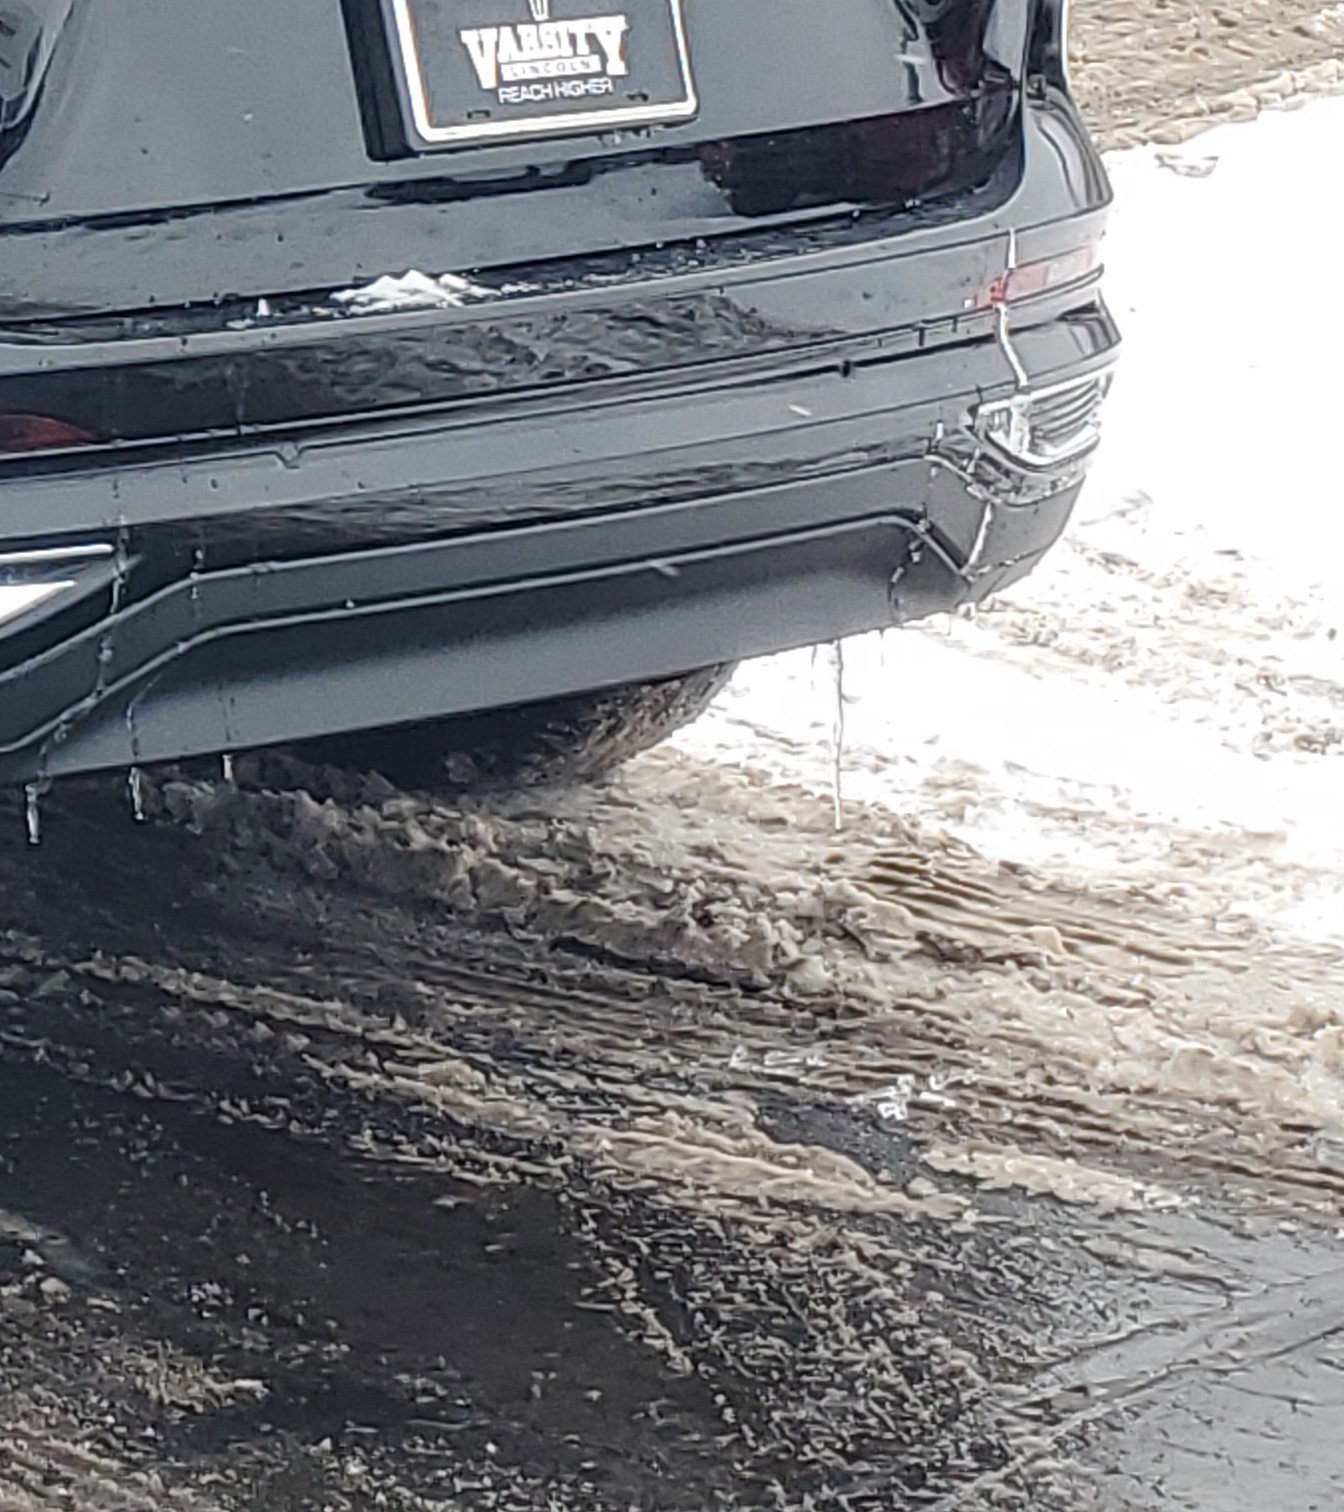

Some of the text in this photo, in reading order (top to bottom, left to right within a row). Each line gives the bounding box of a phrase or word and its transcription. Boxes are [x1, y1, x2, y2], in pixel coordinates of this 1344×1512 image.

[460, 14, 629, 89] VARSITY
[511, 59, 592, 78] LINCOLN
[498, 77, 614, 104] REACH HIGHER
